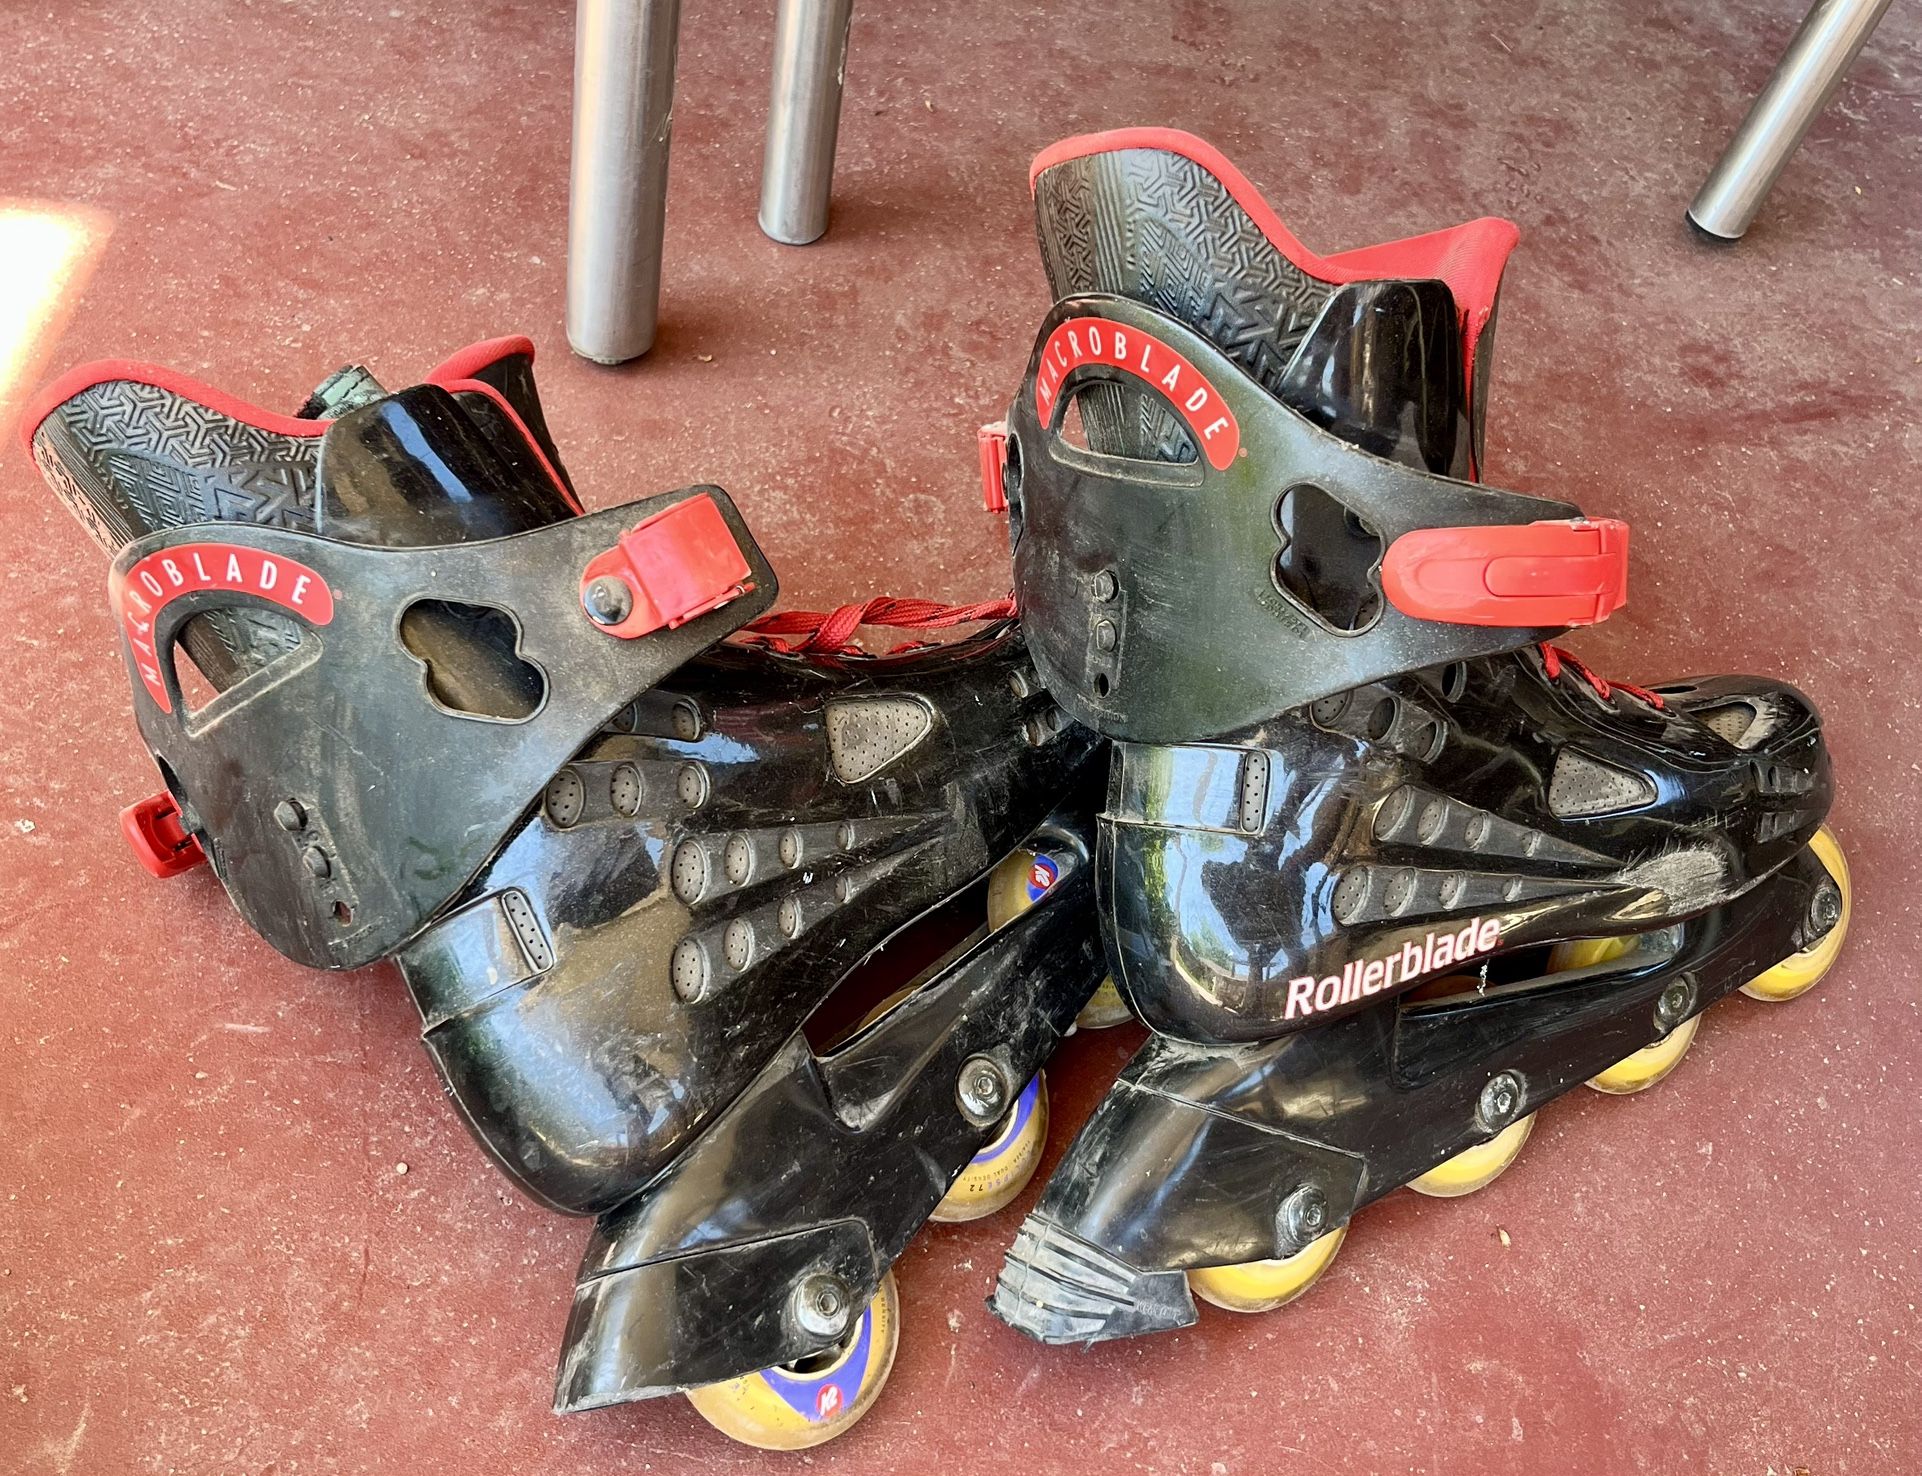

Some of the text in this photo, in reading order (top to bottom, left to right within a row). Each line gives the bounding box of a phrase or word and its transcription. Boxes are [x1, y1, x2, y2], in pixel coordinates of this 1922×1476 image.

[1039, 326, 1229, 441] MACROBLADE
[127, 552, 311, 686] MACROBLADE
[1034, 864, 1050, 887] K2
[1284, 916, 1501, 1020] Rollerblade
[993, 1166, 1008, 1175] DUAL
[969, 1184, 983, 1192] 72
[820, 1385, 838, 1416] K2
